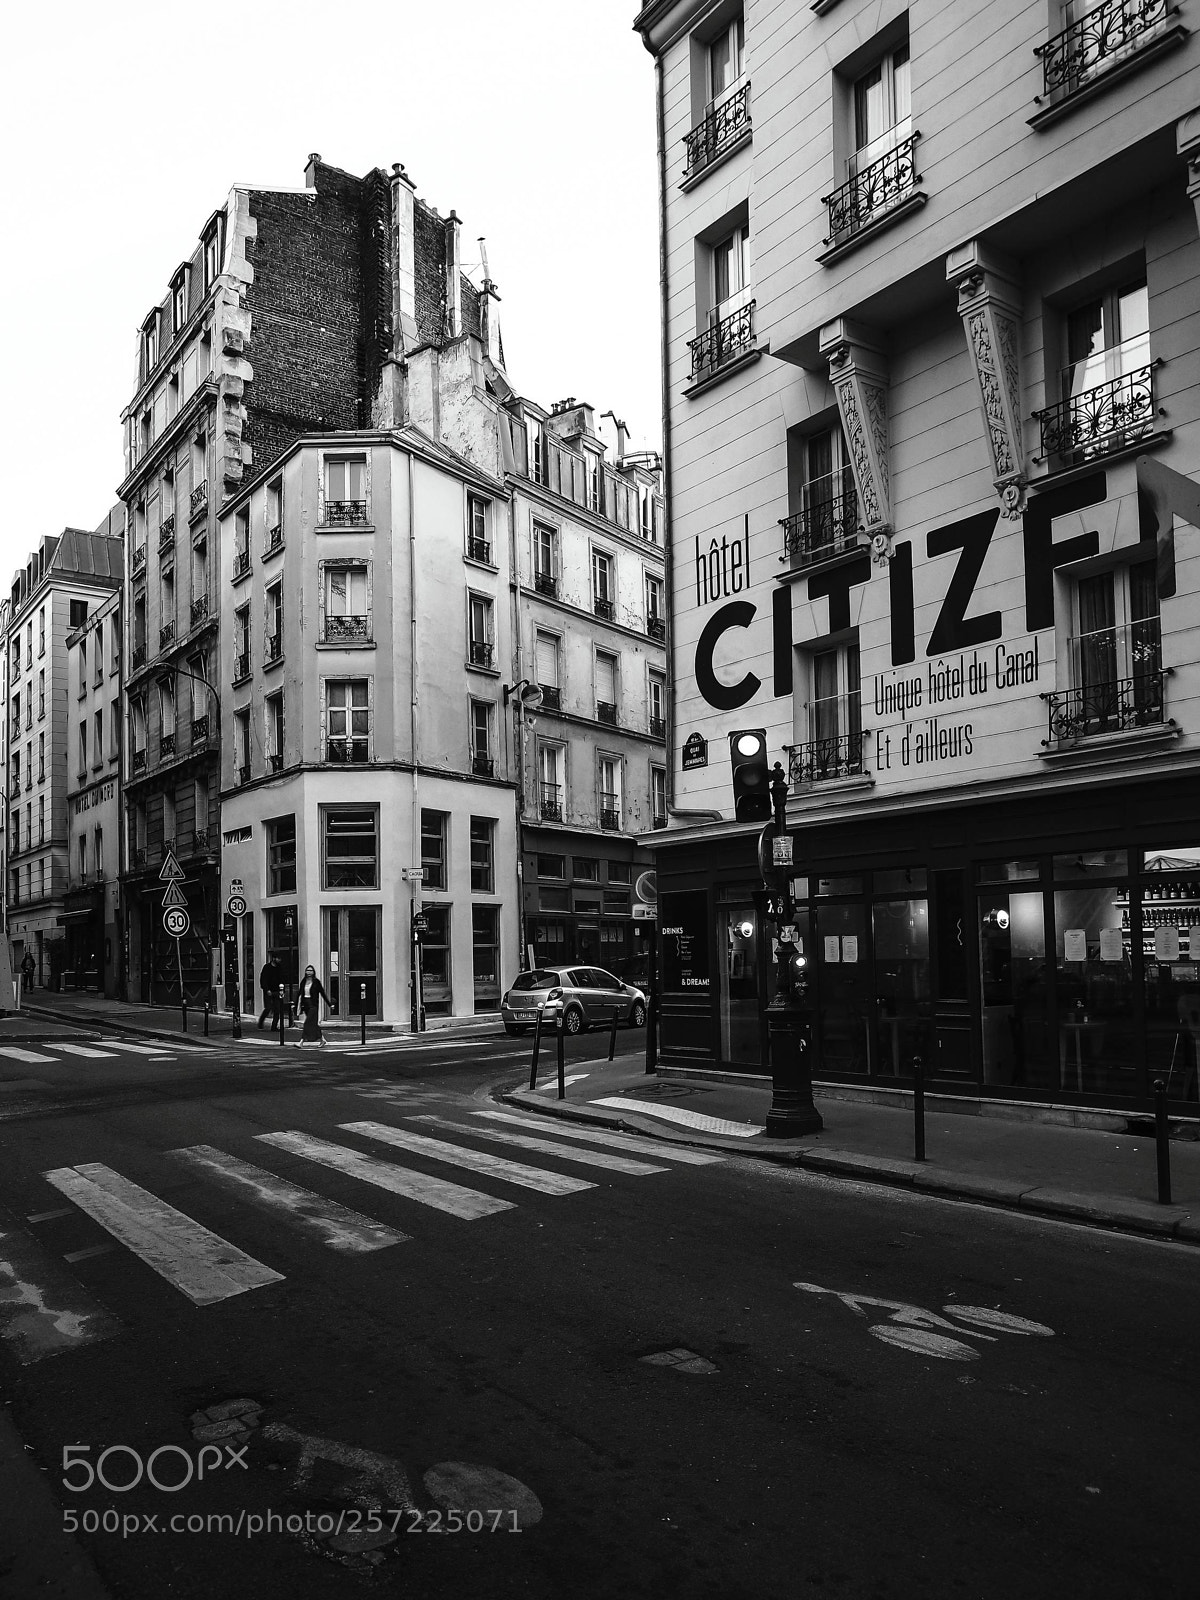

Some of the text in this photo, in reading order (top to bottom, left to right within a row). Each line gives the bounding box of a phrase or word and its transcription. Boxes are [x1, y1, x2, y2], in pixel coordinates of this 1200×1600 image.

[696, 513, 750, 607] hôtel
[875, 636, 1038, 720] Unique hôtel du Canal
[877, 719, 973, 770] Et d'ailleurs
[231, 901, 243, 911] 30
[169, 915, 184, 928] 30
[662, 926, 684, 935] DRINKS
[681, 978, 686, 986] &
